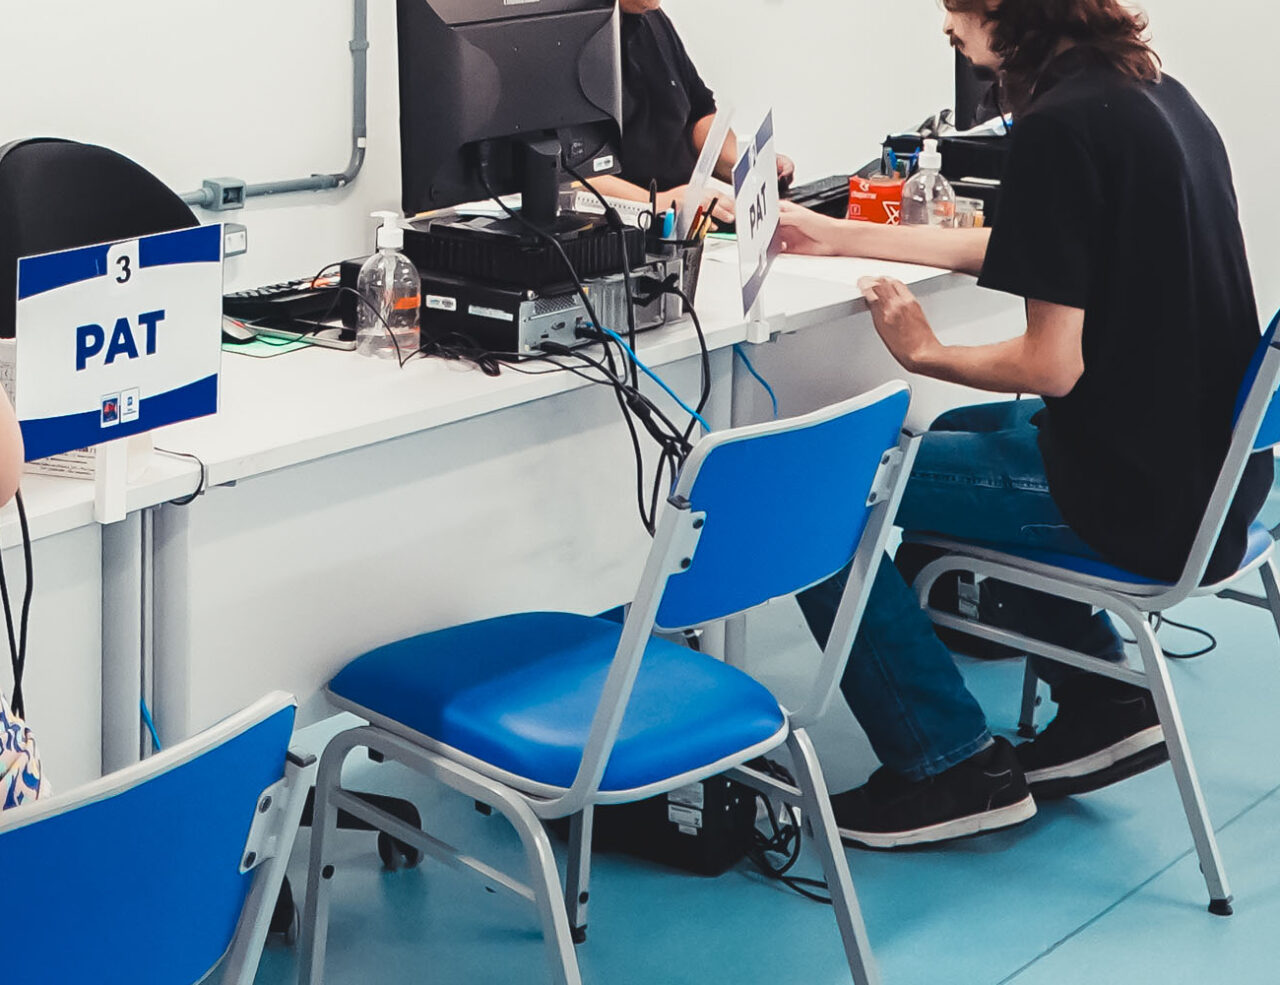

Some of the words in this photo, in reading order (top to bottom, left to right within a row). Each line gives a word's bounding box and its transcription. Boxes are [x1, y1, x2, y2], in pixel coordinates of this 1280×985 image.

[749, 181, 767, 240] PAT
[115, 255, 131, 283] 3
[76, 309, 165, 371] PAT
